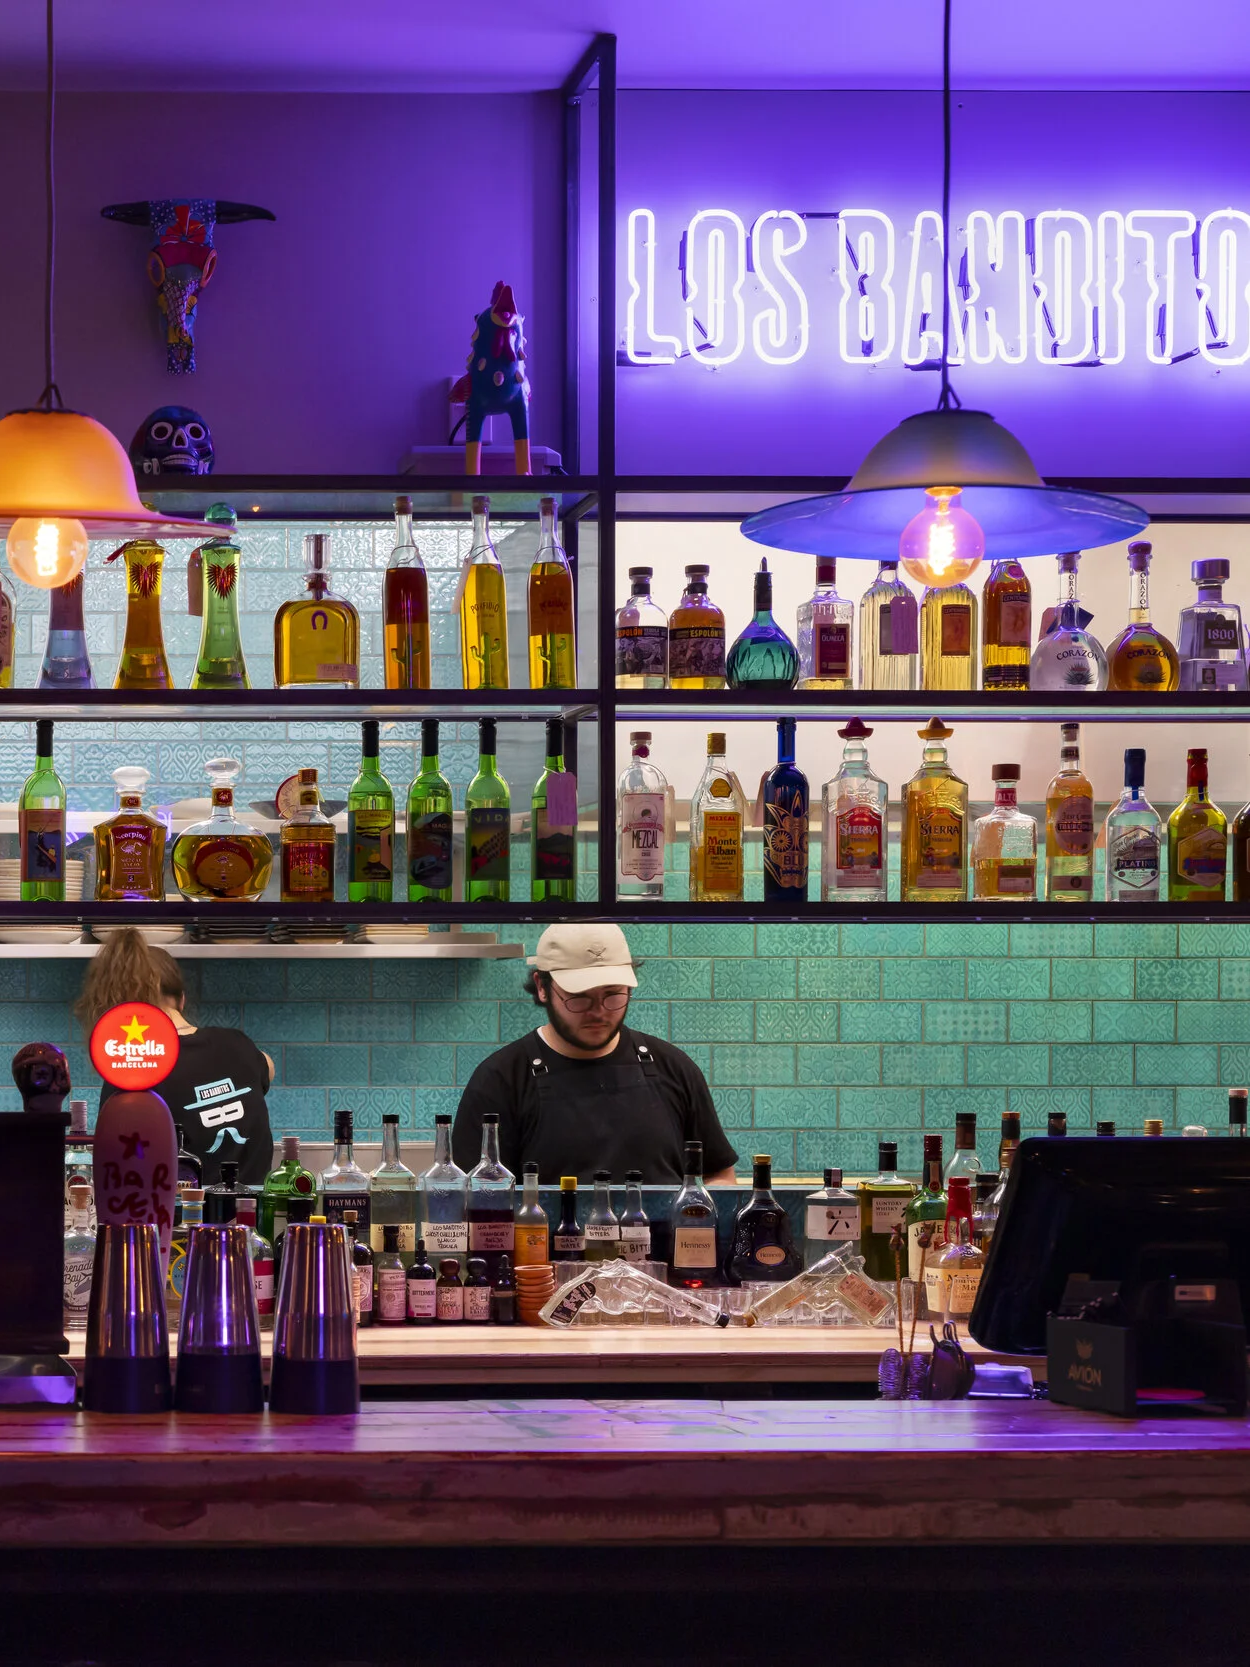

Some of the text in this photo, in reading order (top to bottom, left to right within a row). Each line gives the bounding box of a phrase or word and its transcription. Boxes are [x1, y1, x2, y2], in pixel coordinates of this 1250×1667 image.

[627, 208, 810, 366] LOS
[1207, 628, 1235, 640] 1800
[839, 822, 879, 836] SIERRA
[919, 822, 960, 836] SIERRA
[632, 829, 659, 849] MEZCAL
[707, 836, 738, 846] Monte
[707, 845, 737, 856] Alban
[1118, 860, 1156, 868] PLATINO
[104, 1039, 165, 1057] Estrella
[200, 1088, 211, 1099] LOS
[680, 1242, 711, 1251] Hennessy
[760, 1251, 782, 1259] Hennessy
